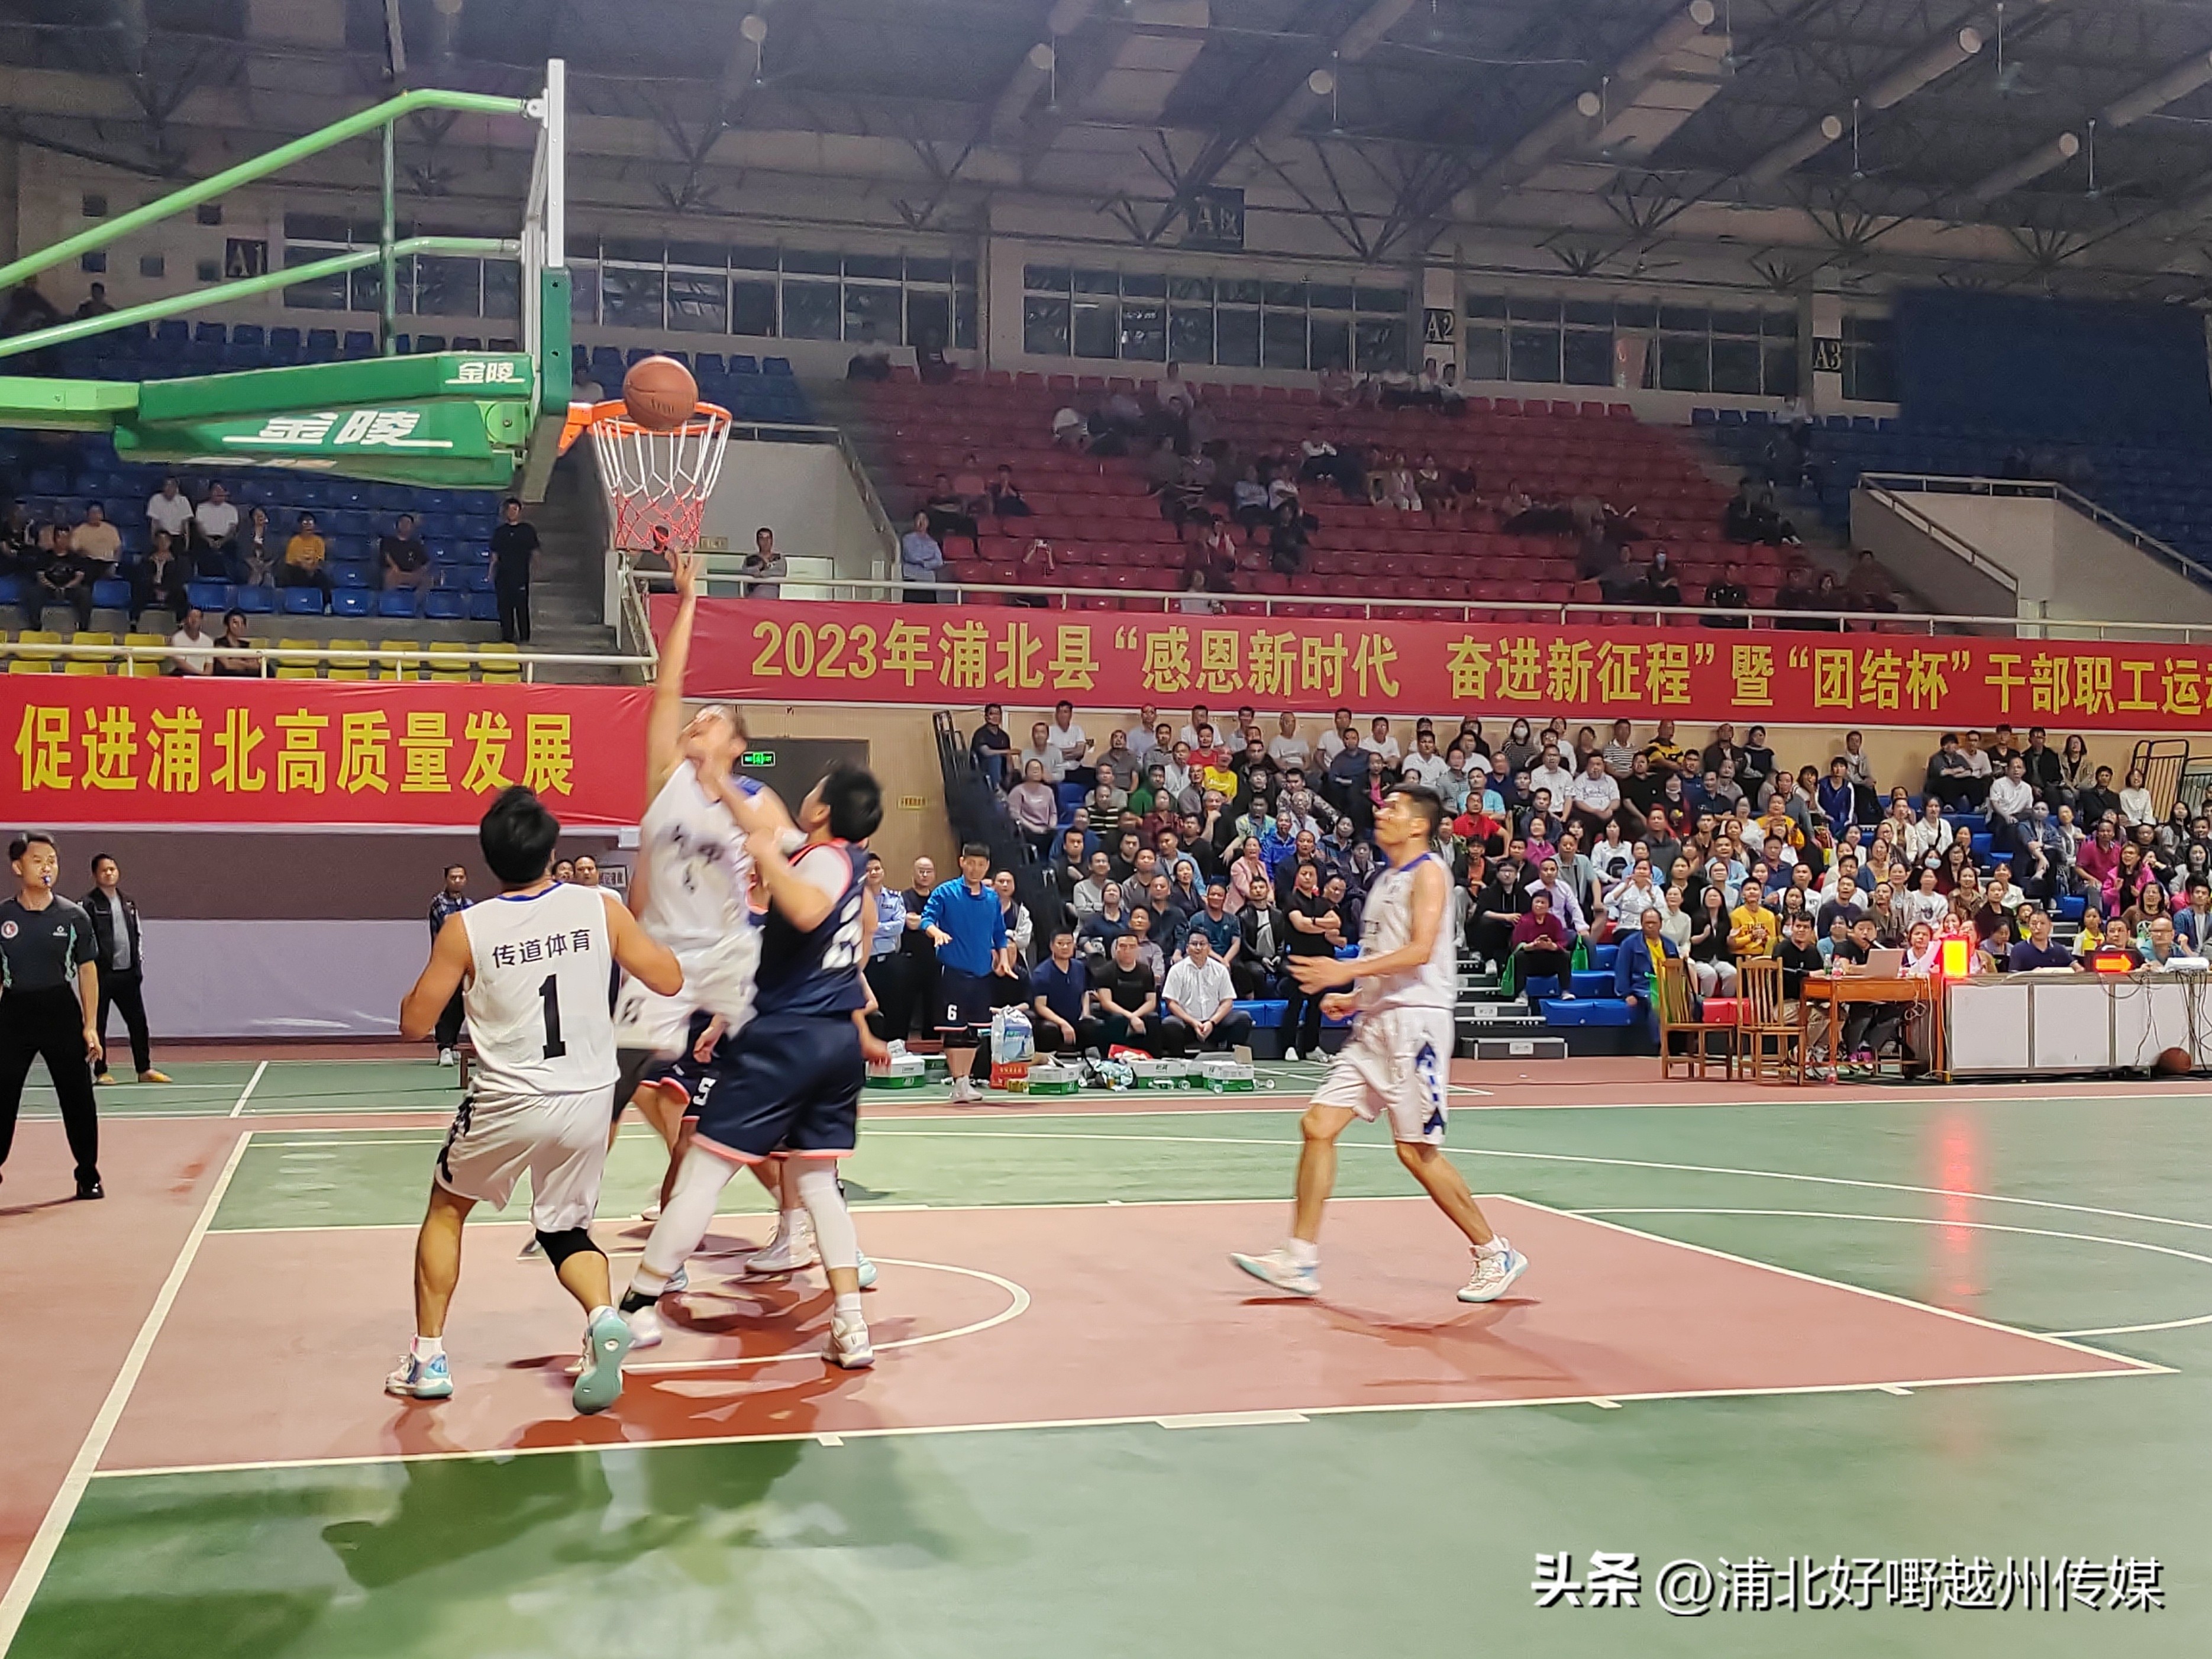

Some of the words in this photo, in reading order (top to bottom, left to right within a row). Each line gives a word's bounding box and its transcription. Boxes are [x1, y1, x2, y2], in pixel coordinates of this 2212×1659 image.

[228, 243, 263, 277] A1
[1425, 312, 1454, 341] A2
[1813, 341, 1842, 370] A3
[445, 362, 525, 384] 金陵
[222, 411, 454, 448] 金陵
[752, 619, 1399, 698] 2023年浦北县“感恩新时代
[1446, 635, 2212, 715] 奋进新征程”暨“团结杯”干部职工运
[15, 704, 574, 796] 促进浦北高质量发展
[492, 929, 590, 969] 传道体育
[539, 973, 566, 1060] 1
[947, 1004, 958, 1021] 6
[693, 1077, 718, 1106] 5
